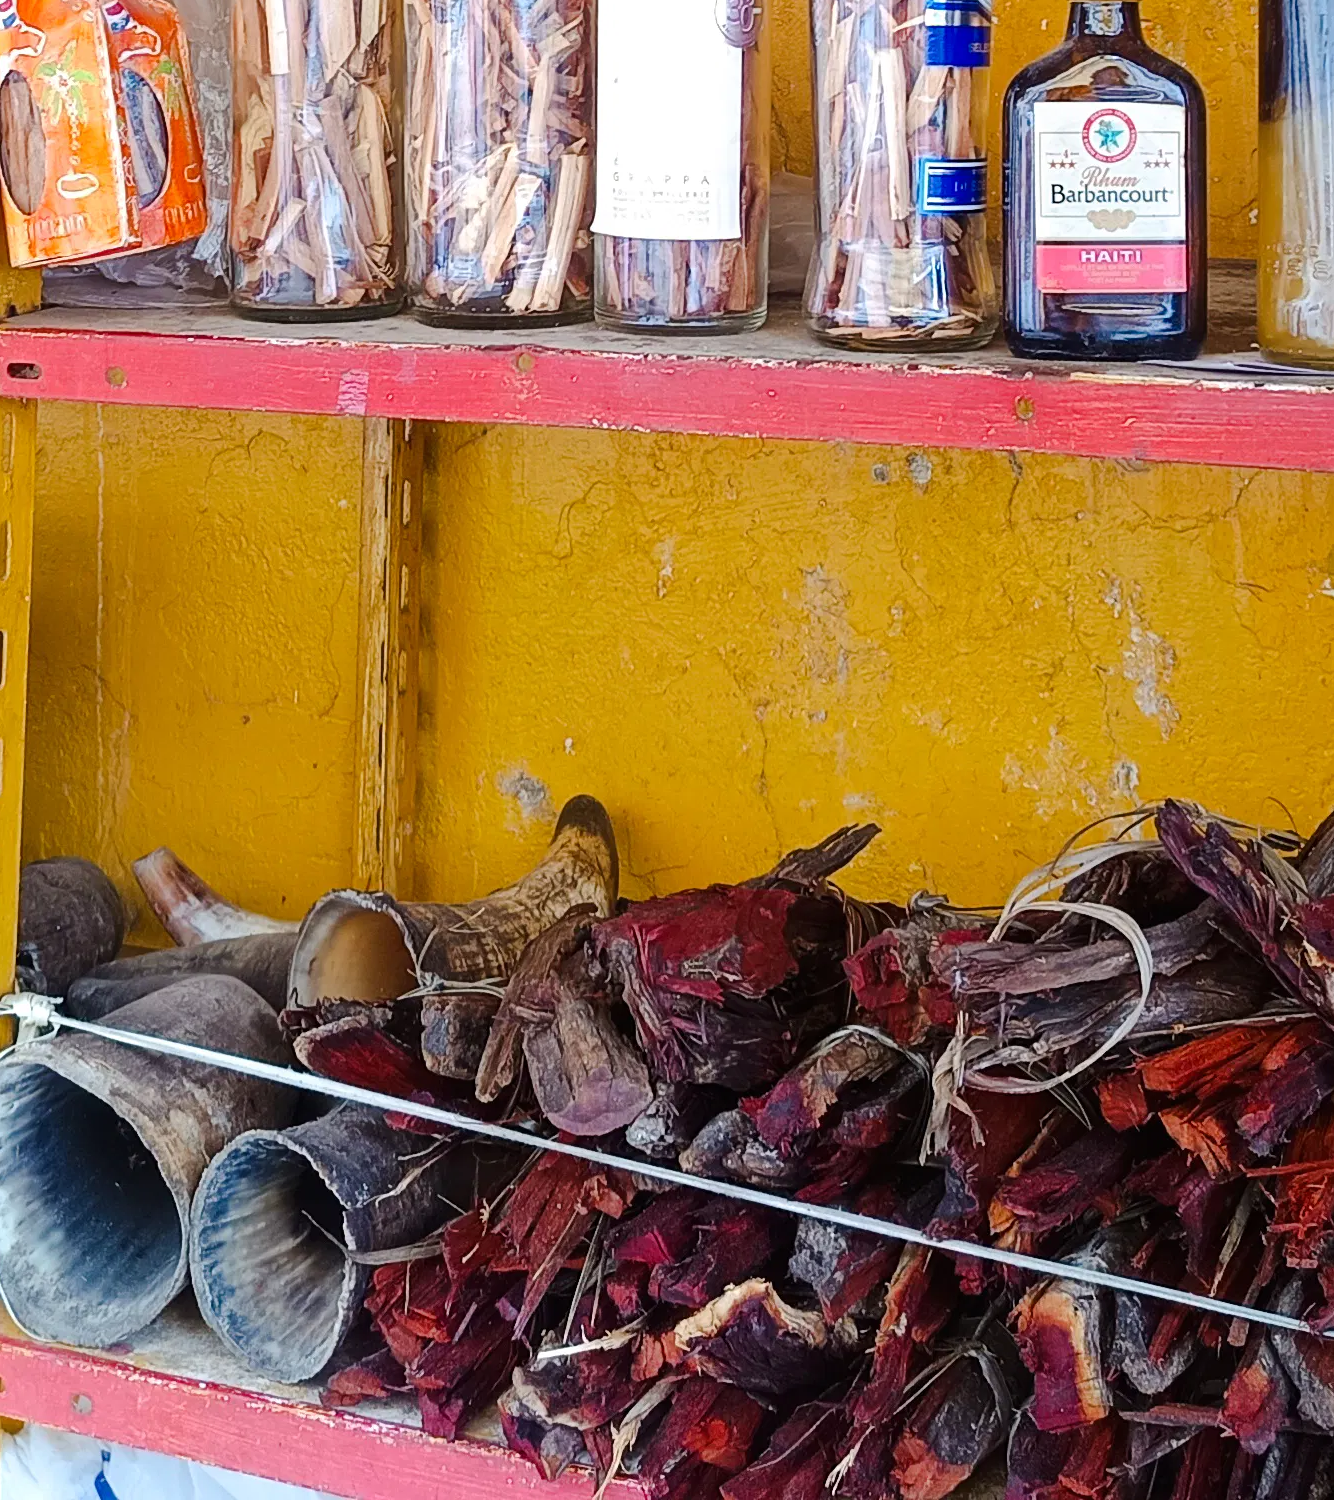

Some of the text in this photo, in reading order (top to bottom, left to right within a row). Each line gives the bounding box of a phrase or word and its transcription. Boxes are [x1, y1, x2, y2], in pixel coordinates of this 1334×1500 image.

[1079, 165, 1141, 188] Rhum
[1051, 183, 1170, 205] Barbancourt
[1079, 249, 1143, 264] HAITI
